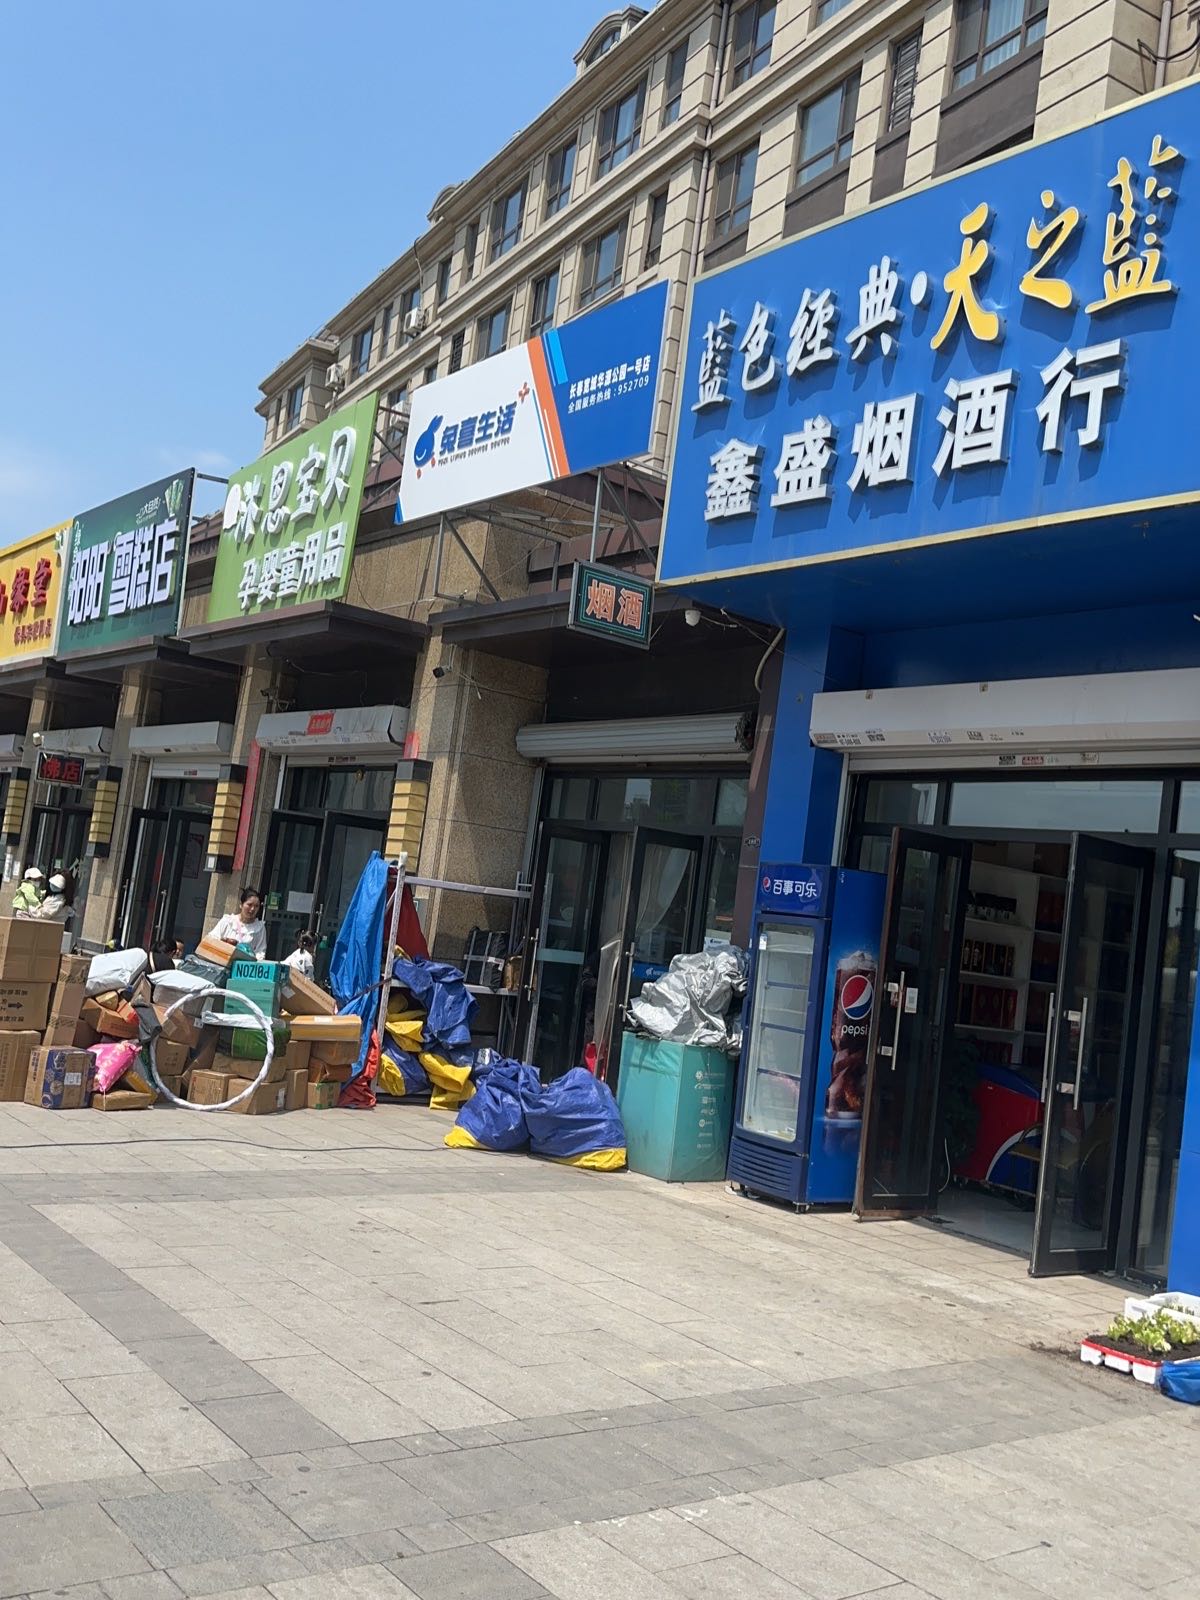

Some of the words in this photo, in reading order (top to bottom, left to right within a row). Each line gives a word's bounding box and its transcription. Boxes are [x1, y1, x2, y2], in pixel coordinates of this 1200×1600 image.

[439, 401, 518, 456] 兔喜生活
[703, 338, 1125, 523] 鑫盛烟酒行
[237, 521, 348, 610] 孕婴童用品
[586, 579, 644, 630] 烟酒
[773, 879, 817, 898] 百事可乐
[840, 1024, 868, 1038] pepsi
